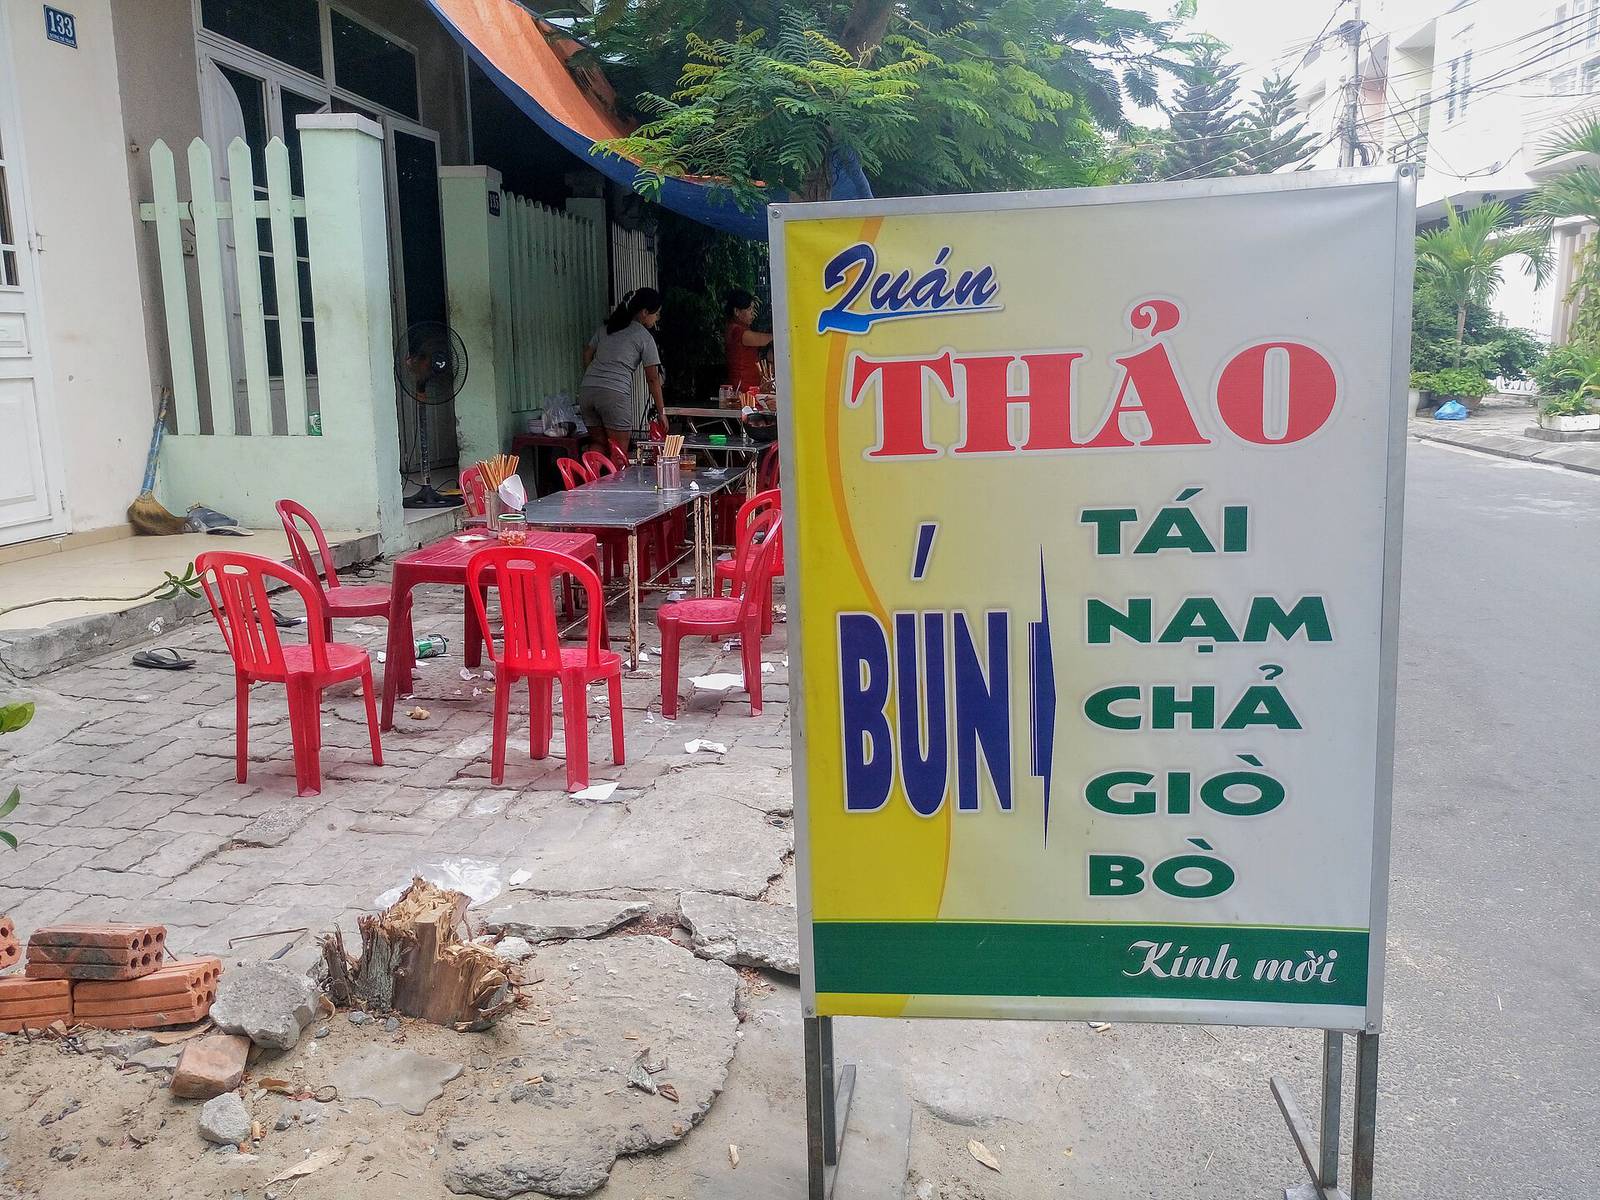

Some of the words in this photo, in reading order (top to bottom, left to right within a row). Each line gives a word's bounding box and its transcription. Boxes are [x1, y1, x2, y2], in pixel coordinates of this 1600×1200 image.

[49, 11, 73, 37] 133
[818, 243, 1001, 333] Quán
[850, 299, 1337, 457] THẢO
[1081, 487, 1249, 554] TÁI
[1086, 596, 1333, 653] NẠM
[837, 523, 1013, 815] BÚN
[1083, 664, 1303, 730] CHẢ
[1084, 754, 1286, 815] GIÒ
[1088, 838, 1235, 898] BÒ
[1122, 940, 1241, 980] Kính
[1252, 949, 1338, 983] mời
